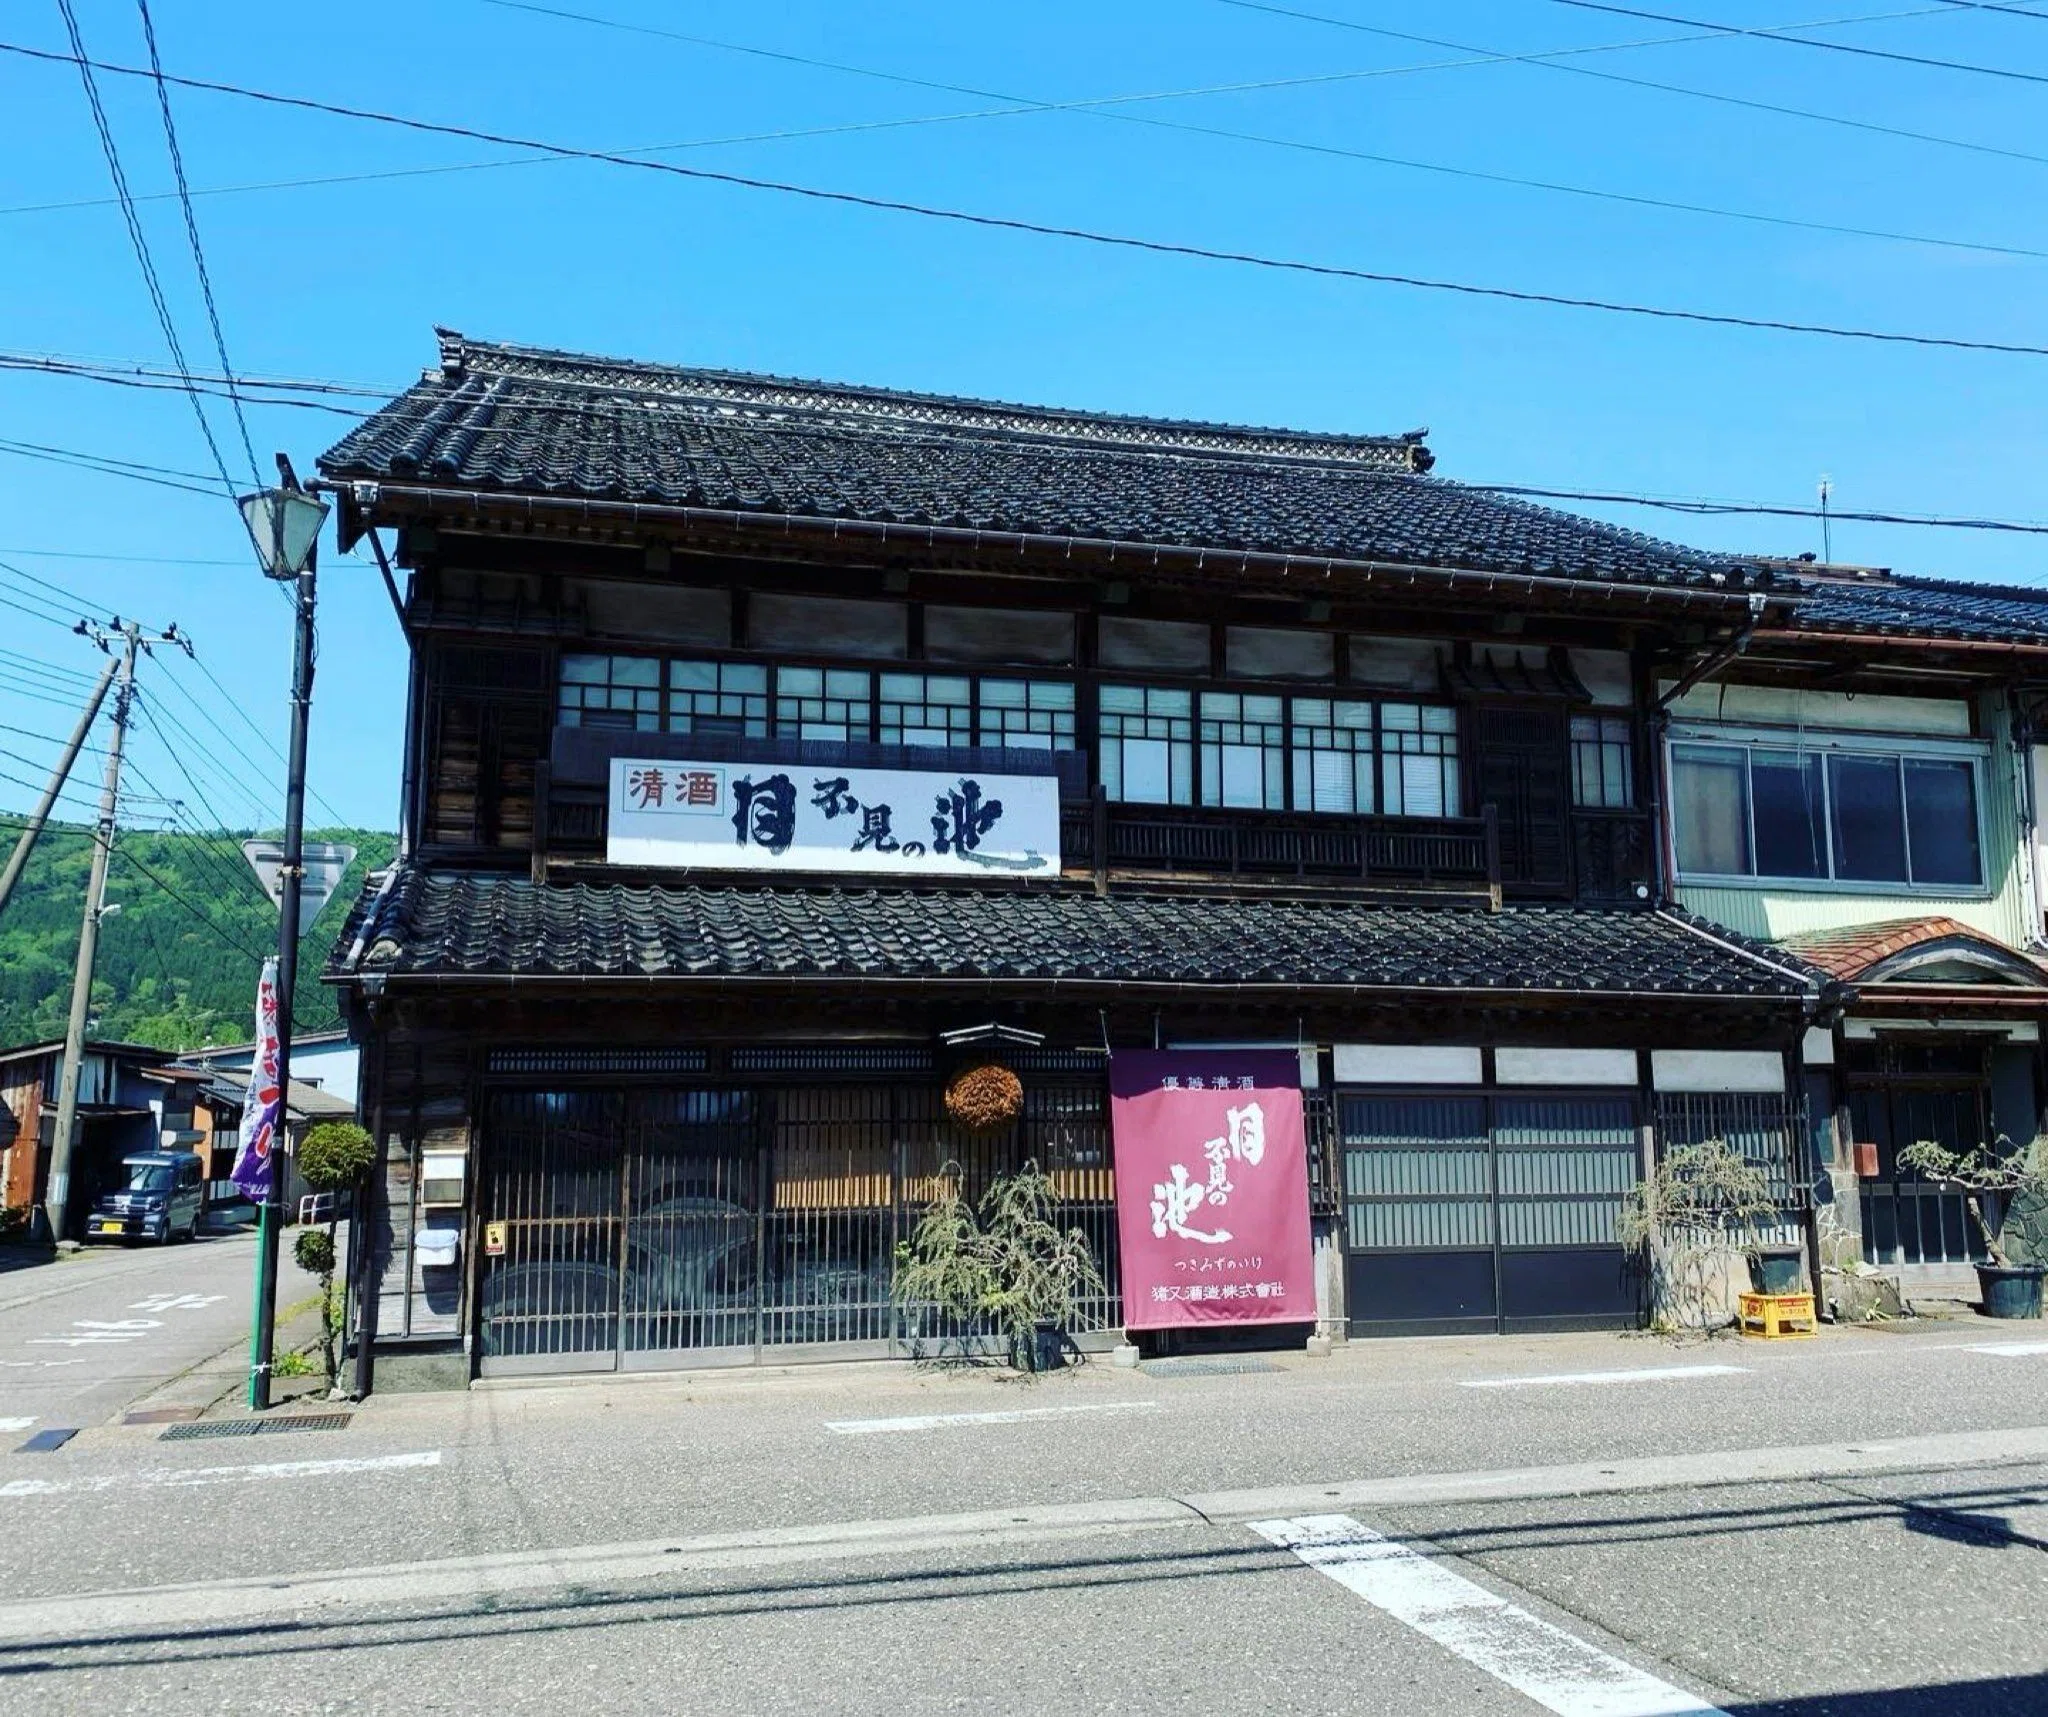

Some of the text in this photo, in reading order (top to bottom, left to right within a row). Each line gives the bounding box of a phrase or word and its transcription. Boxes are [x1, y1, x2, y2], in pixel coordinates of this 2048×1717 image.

[629, 766, 718, 810] 清酒
[731, 772, 1048, 869] 月不見の池
[1150, 1101, 1266, 1244] 月不見の池
